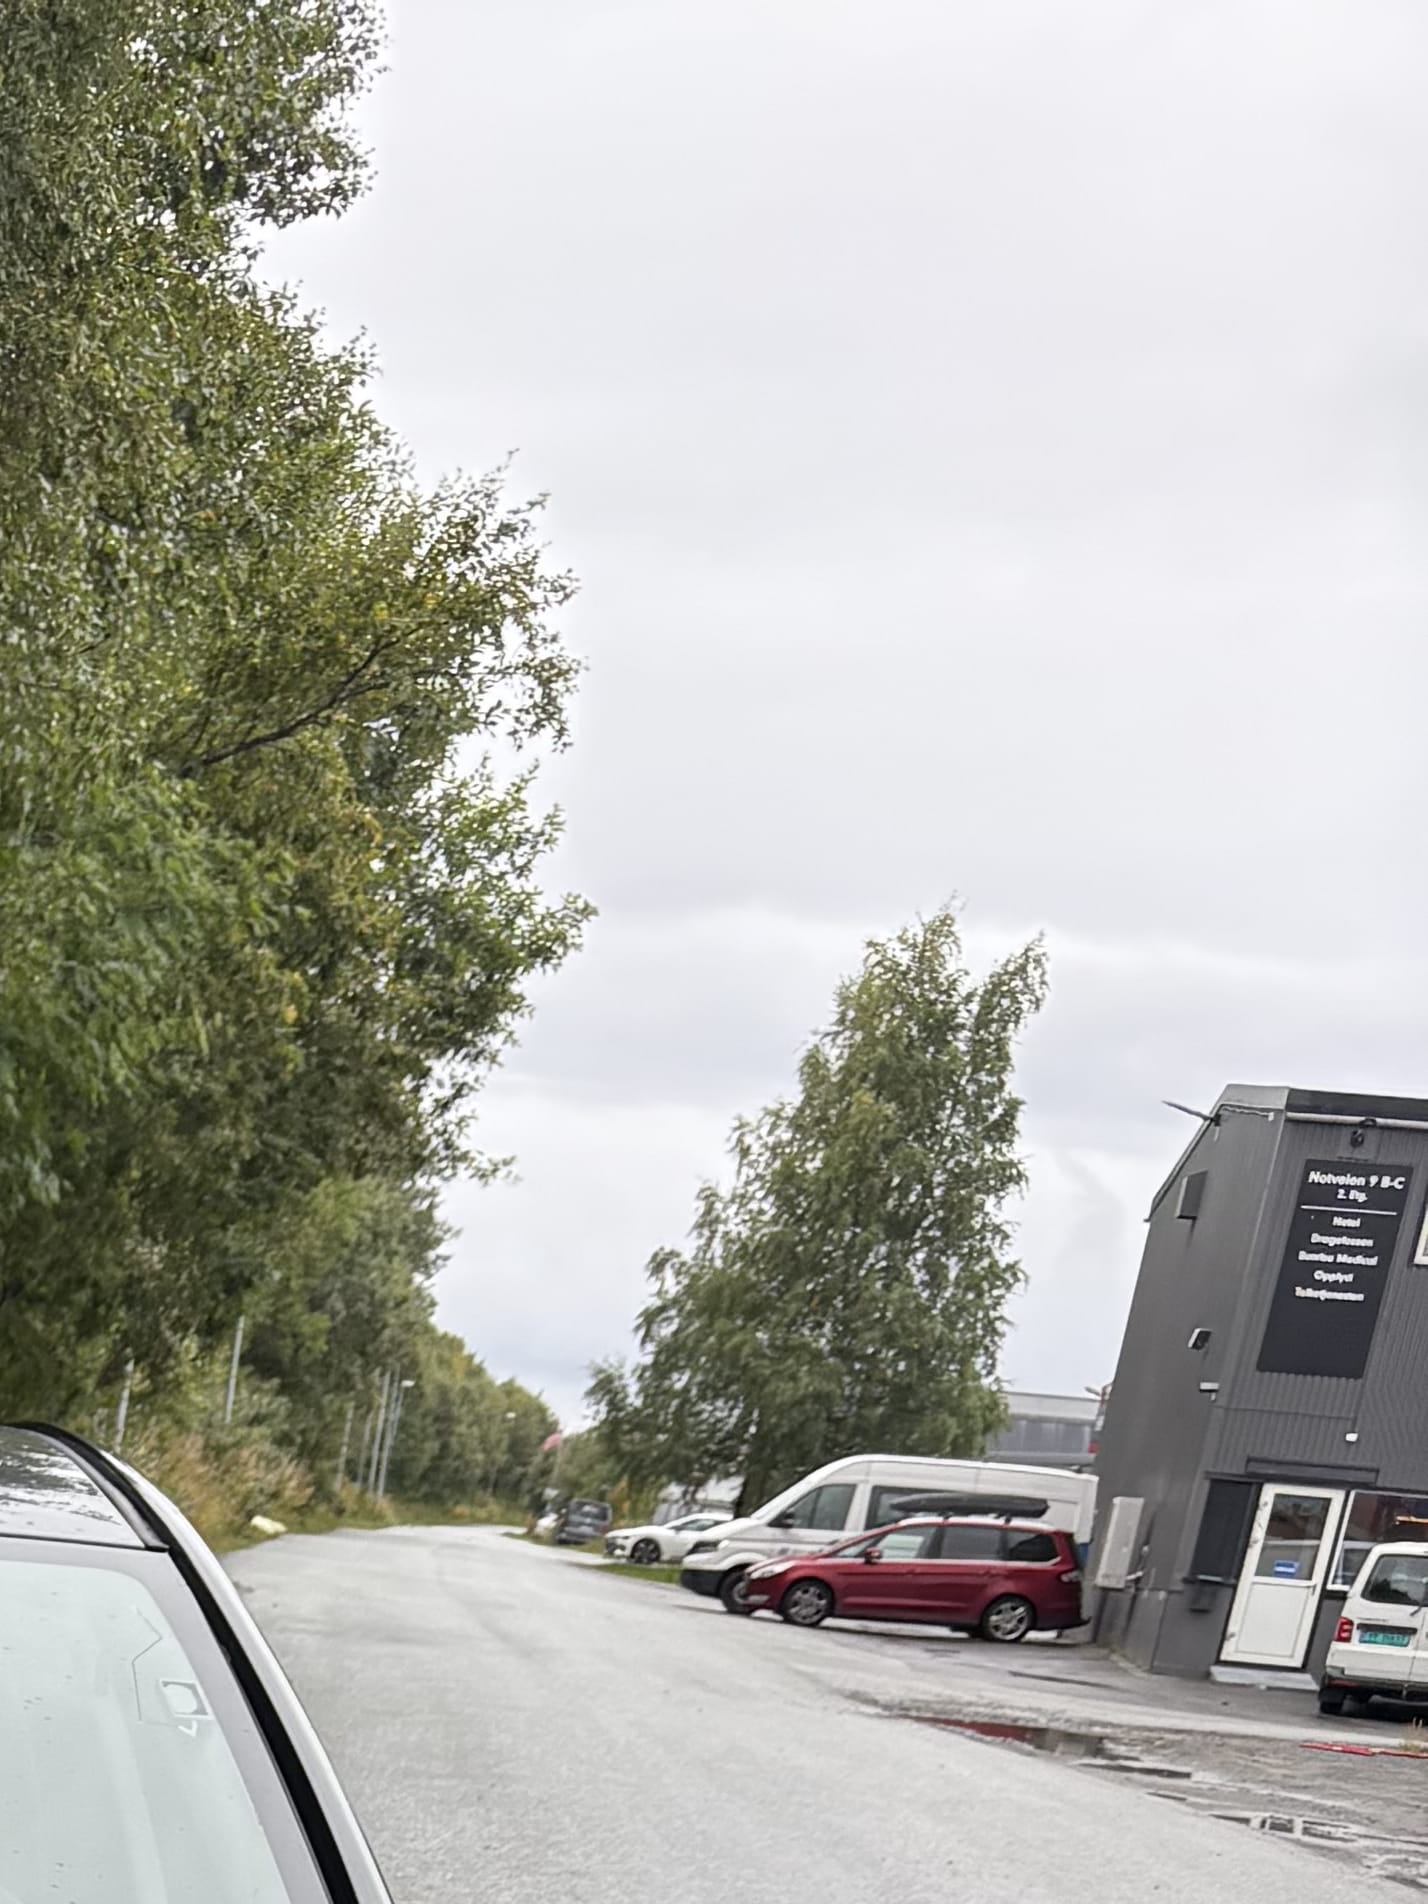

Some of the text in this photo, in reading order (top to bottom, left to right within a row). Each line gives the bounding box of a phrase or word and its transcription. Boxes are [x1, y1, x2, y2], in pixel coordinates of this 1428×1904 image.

[1308, 1170, 1406, 1190] Notveien 9 B-C
